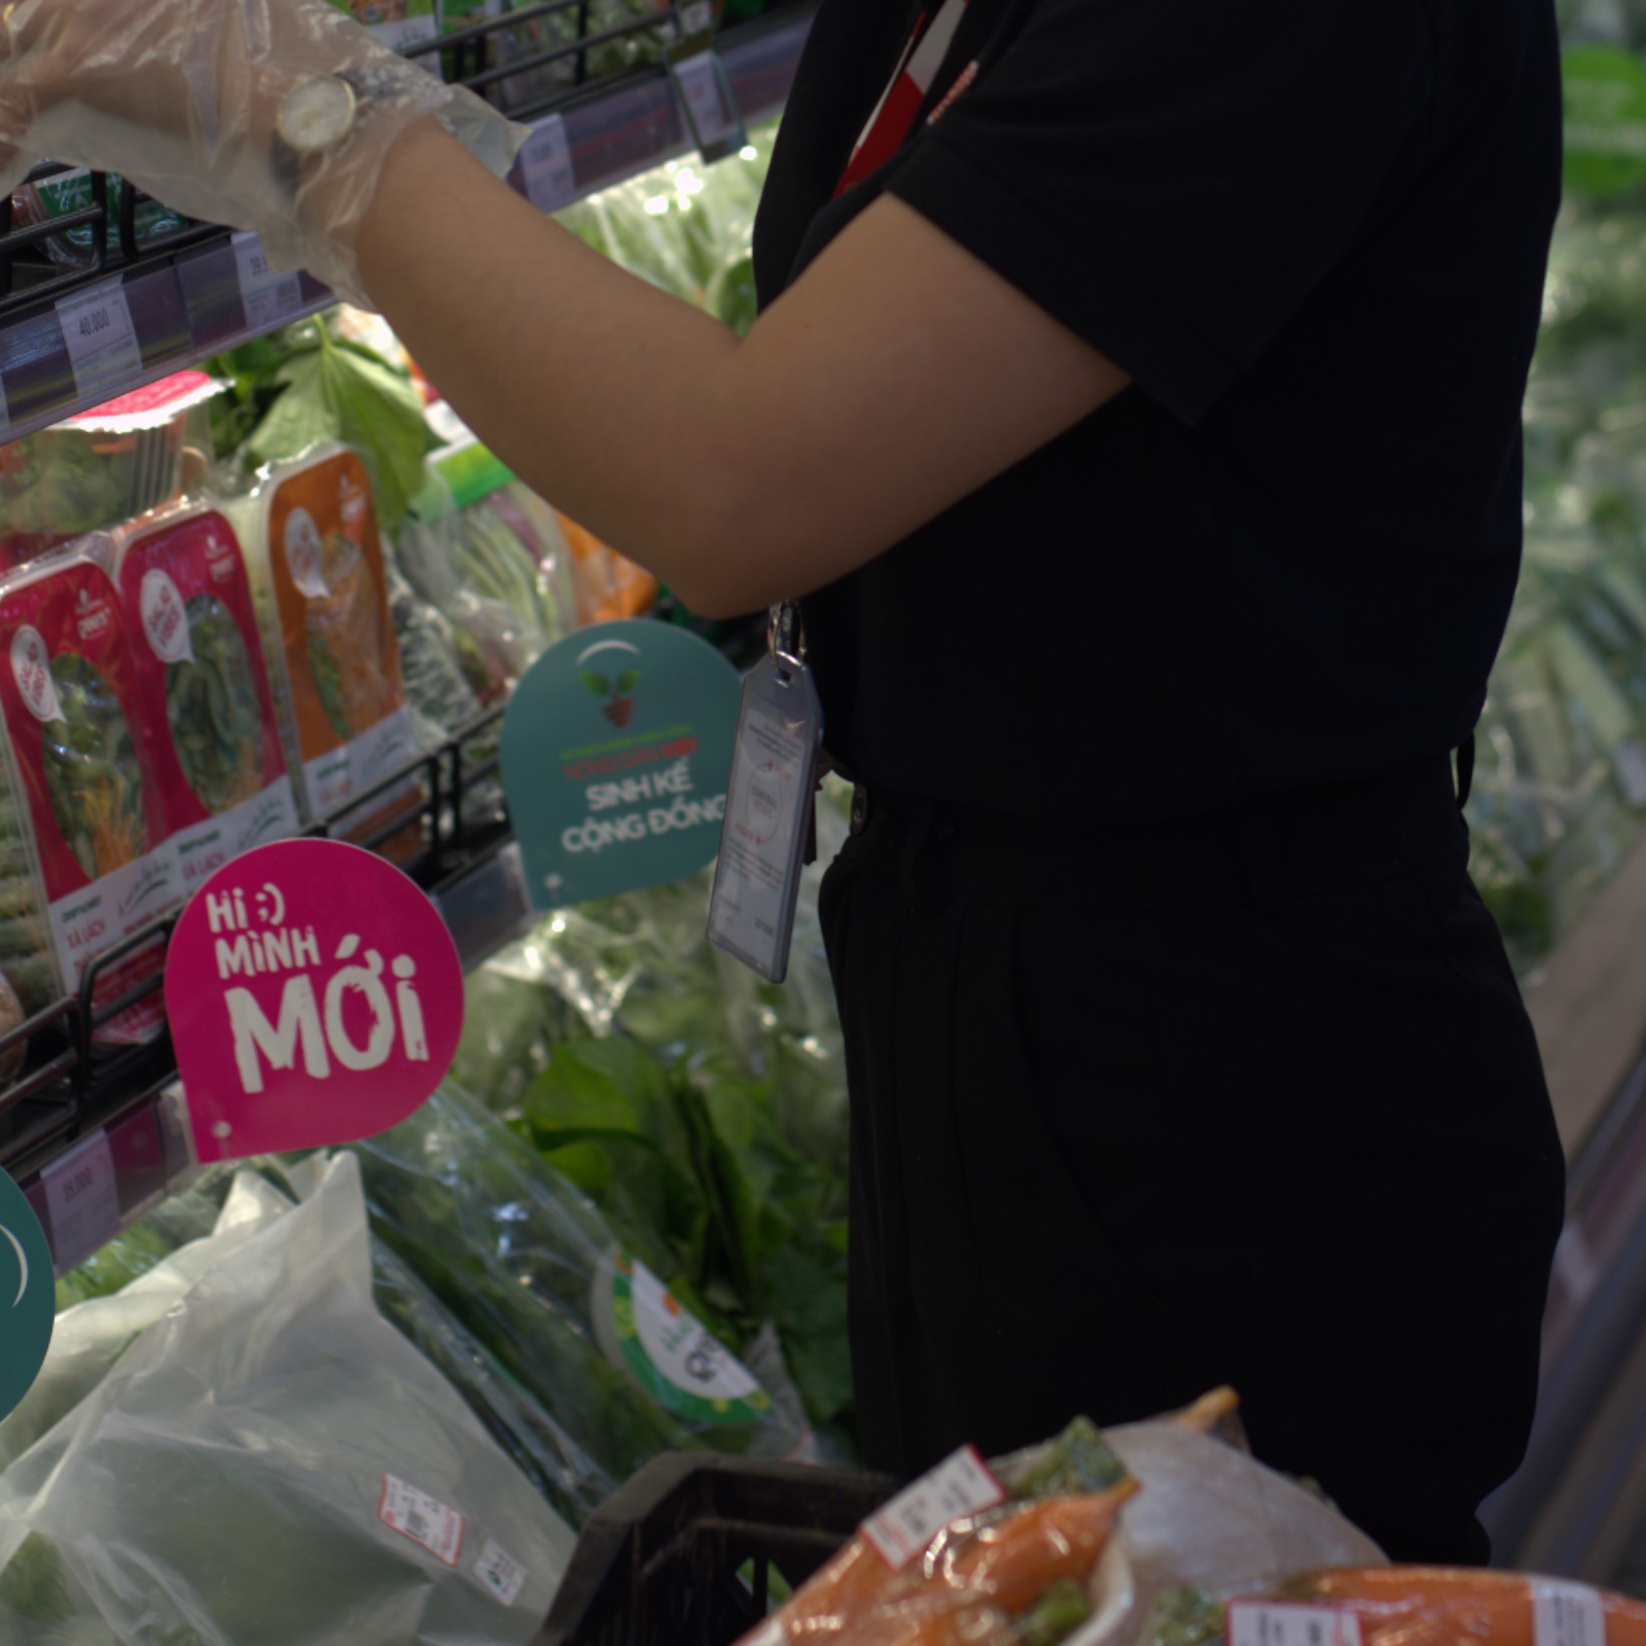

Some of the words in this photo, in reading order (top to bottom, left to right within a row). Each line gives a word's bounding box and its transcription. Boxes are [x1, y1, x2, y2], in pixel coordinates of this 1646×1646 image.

[78, 308, 110, 339] 40.000
[585, 773, 652, 811] SINH
[652, 755, 694, 796] KẾ
[561, 815, 646, 852] CỘNG
[206, 887, 248, 934] Hi
[214, 925, 322, 980] MÌNH
